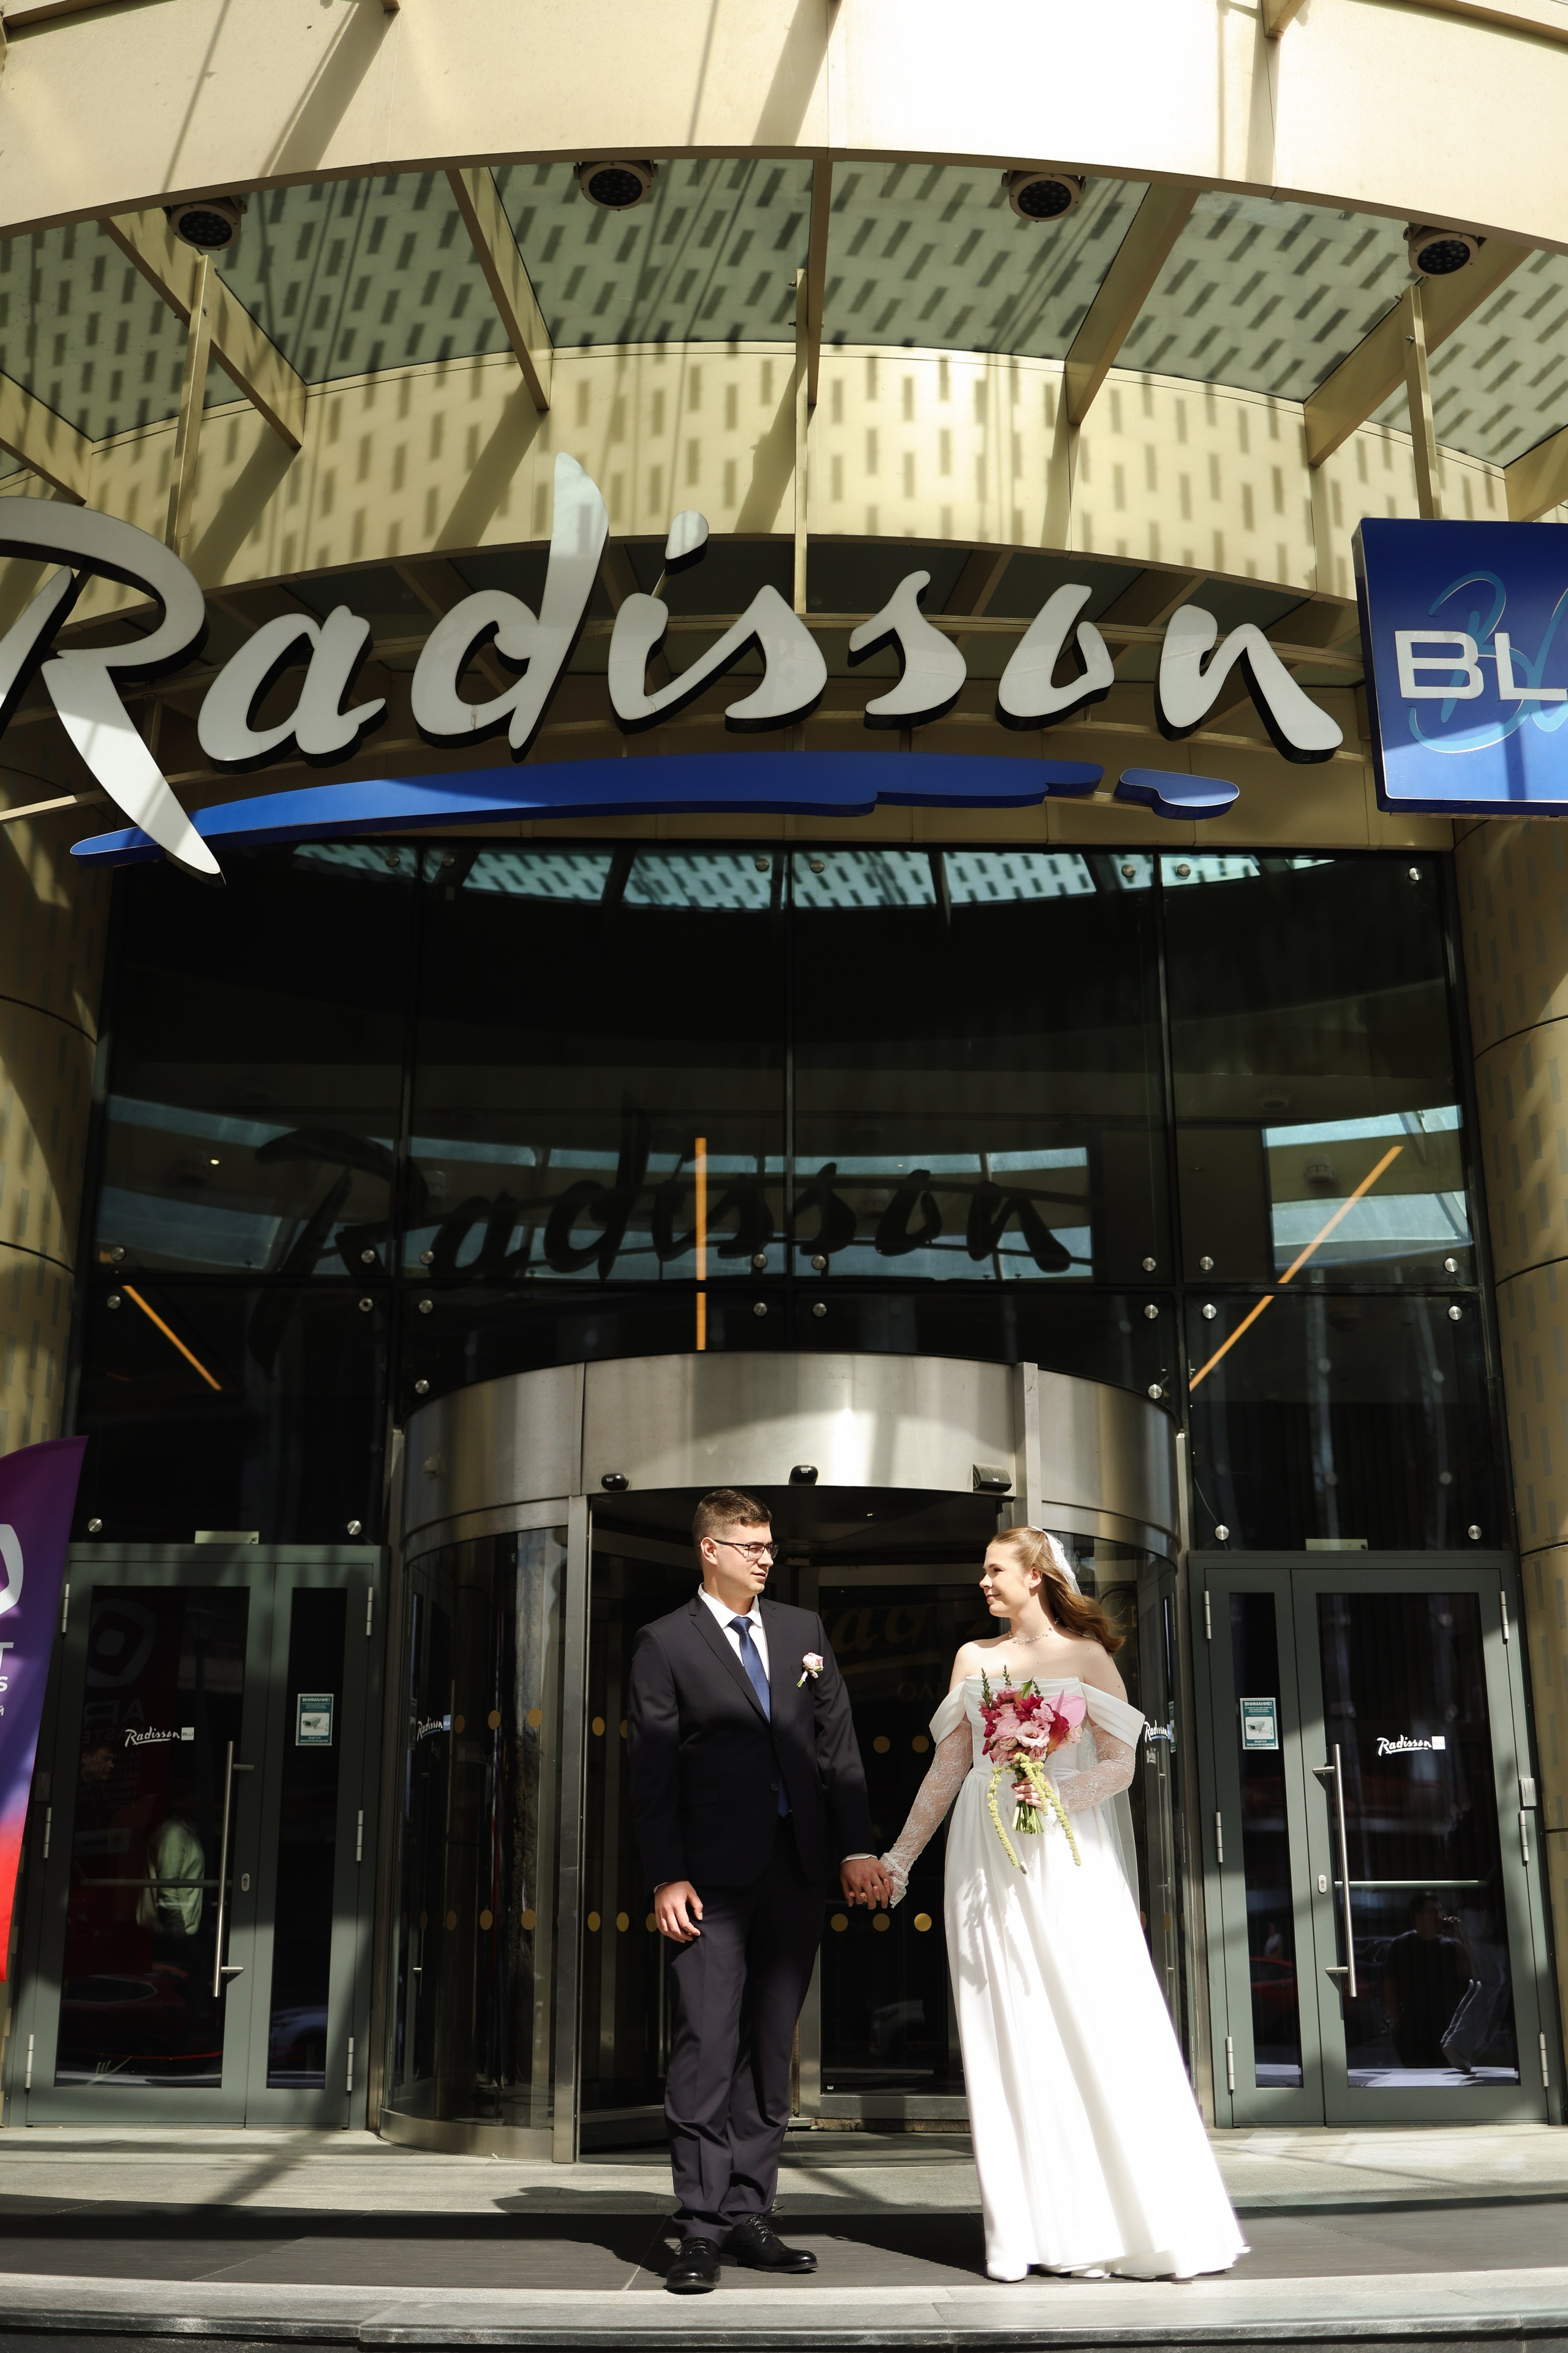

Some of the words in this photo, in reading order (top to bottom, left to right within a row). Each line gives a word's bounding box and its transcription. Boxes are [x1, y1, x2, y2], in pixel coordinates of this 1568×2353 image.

[0, 451, 1344, 880] Radisson
[1395, 630, 1568, 701] BL
[124, 1726, 180, 1748] Radisson
[417, 1716, 443, 1742] Radisson
[1376, 1734, 1432, 1756] Radisson
